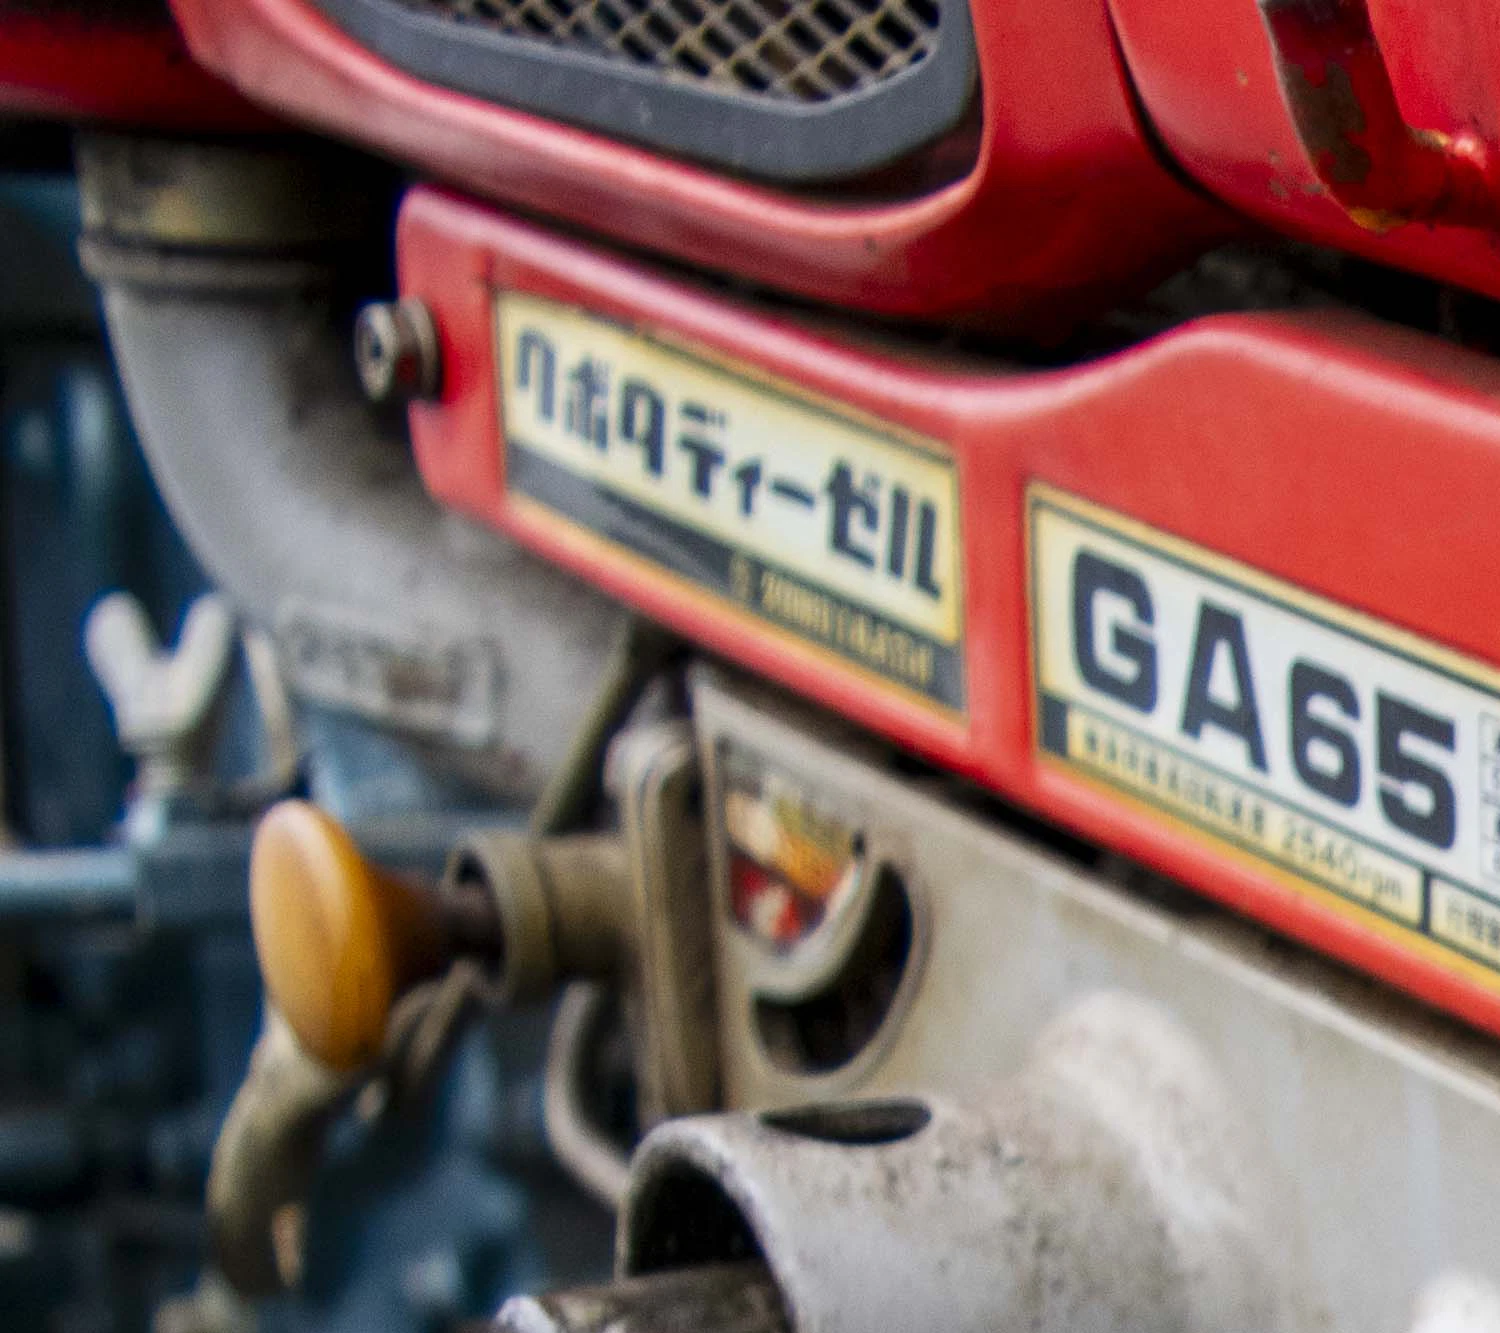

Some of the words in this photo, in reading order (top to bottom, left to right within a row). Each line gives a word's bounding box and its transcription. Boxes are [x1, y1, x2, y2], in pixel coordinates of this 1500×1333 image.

[517, 327, 942, 602] クボタディーゼル
[1071, 545, 1458, 850] GA65
